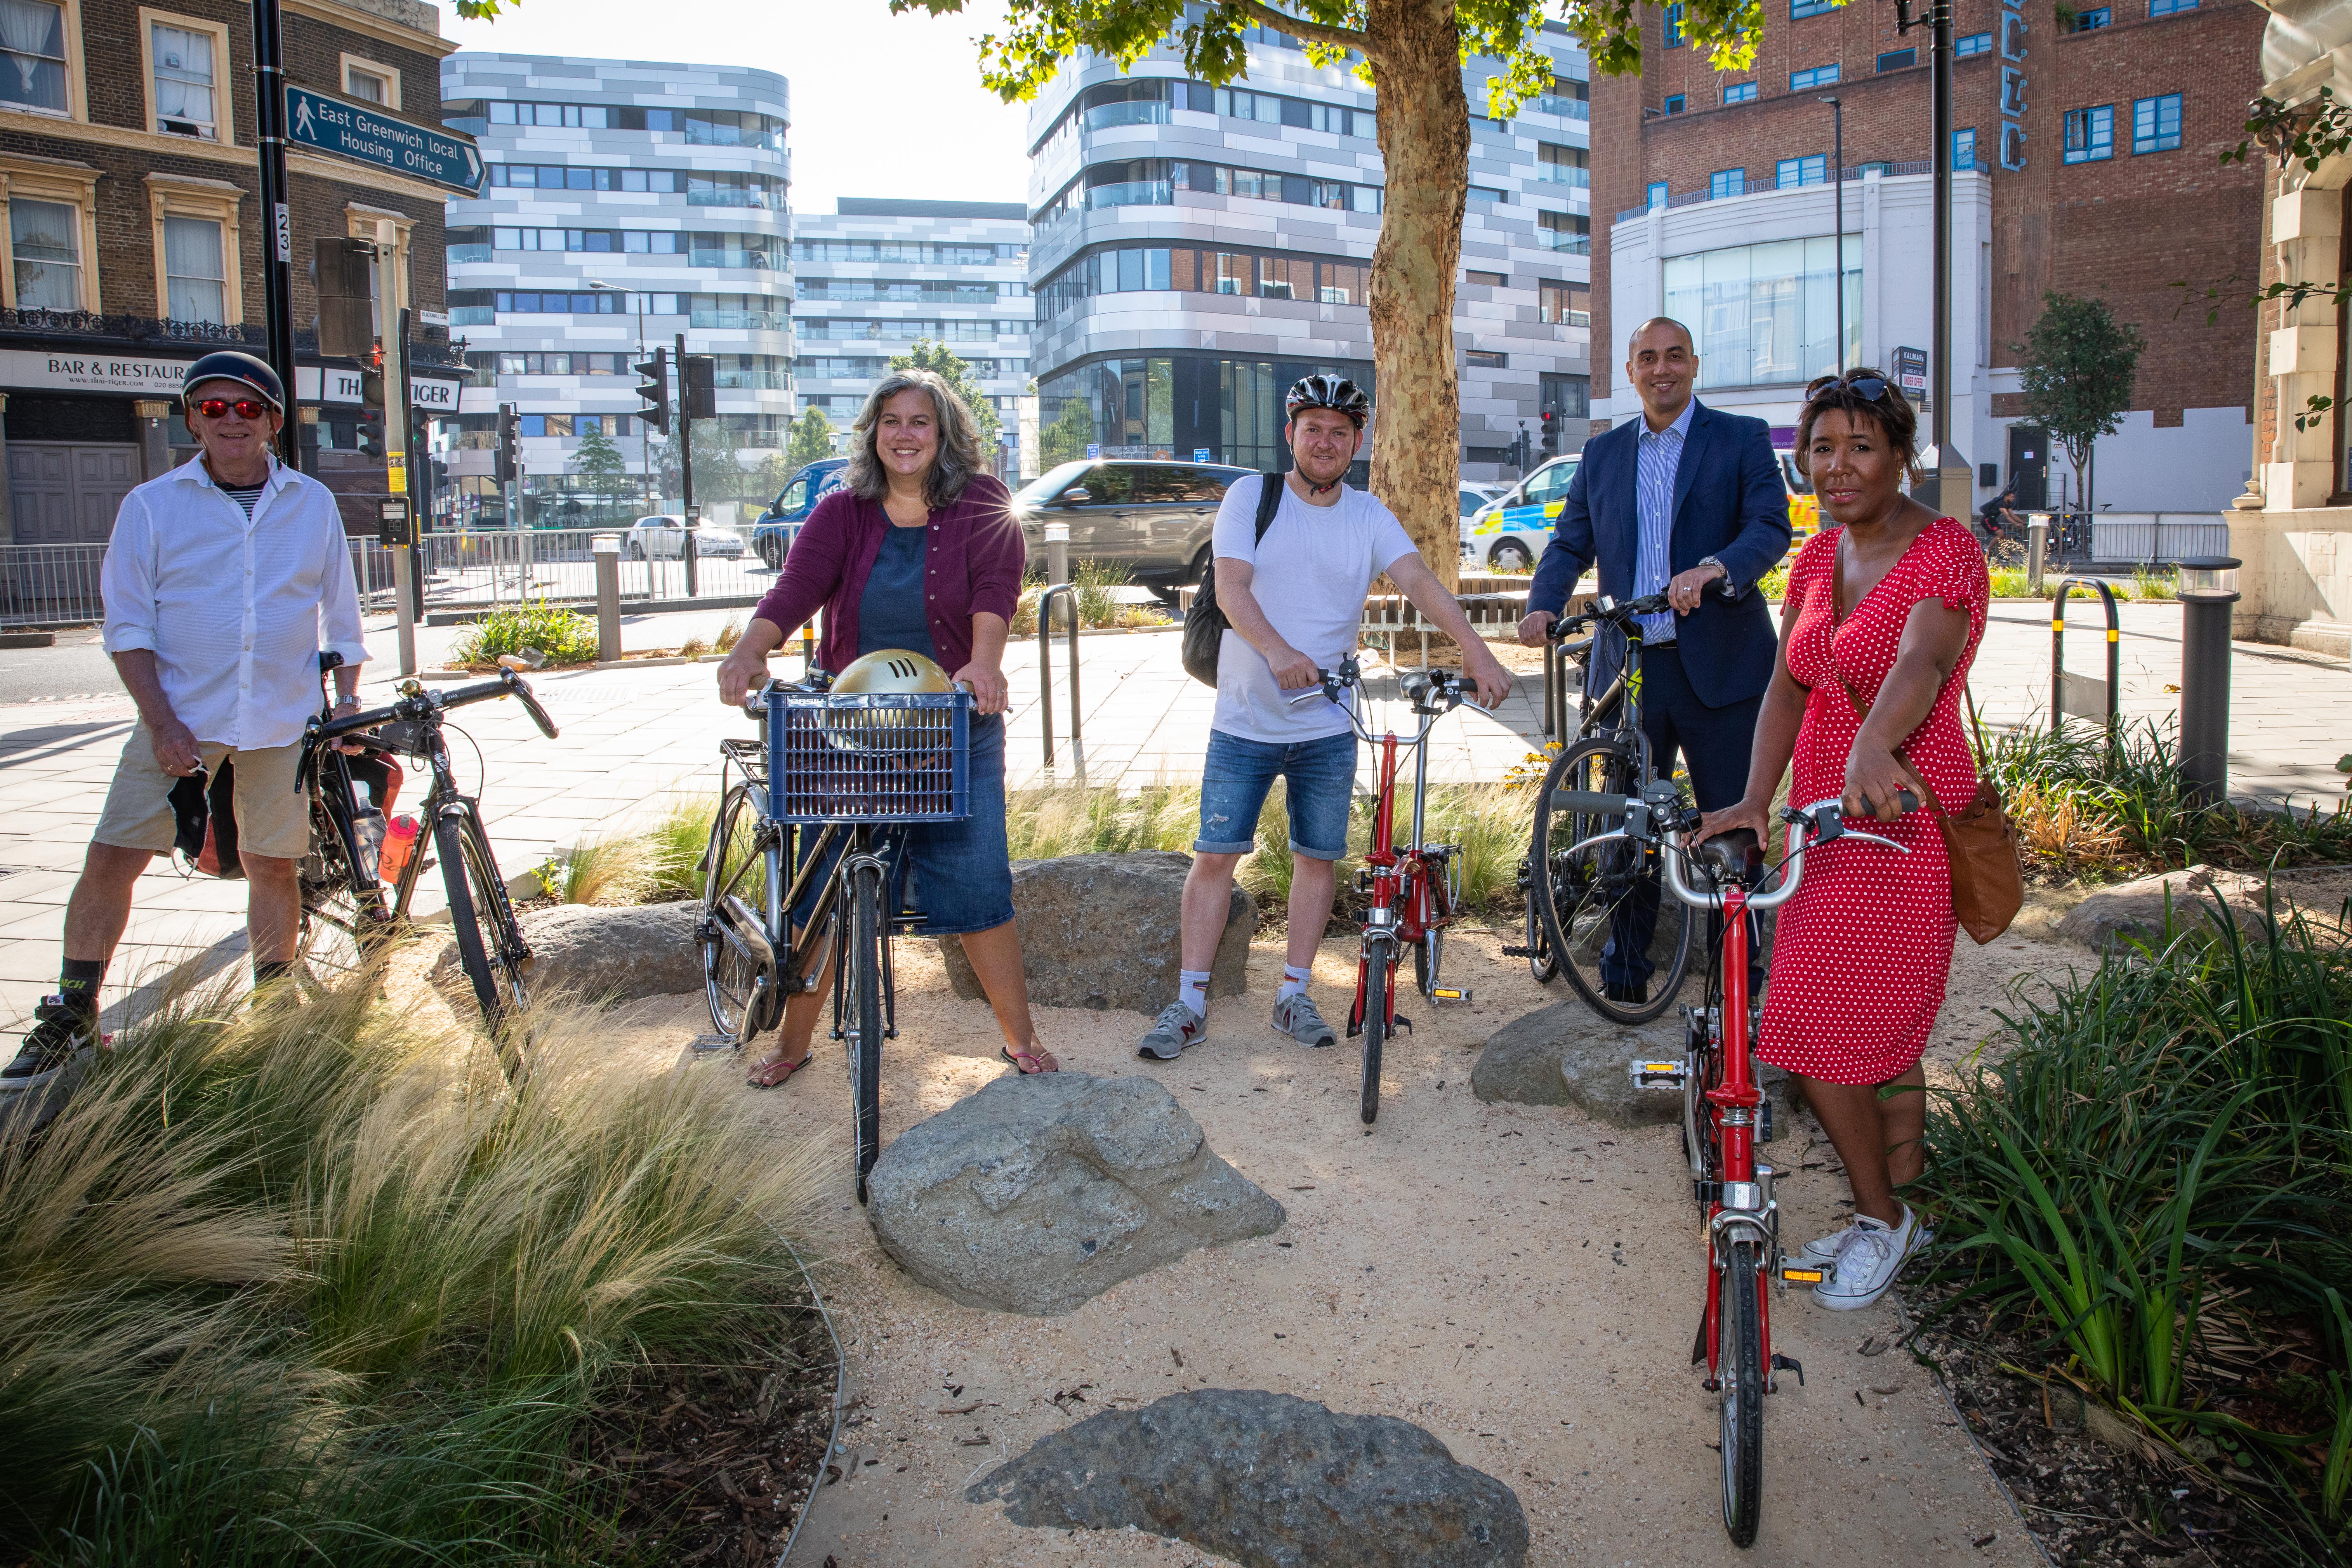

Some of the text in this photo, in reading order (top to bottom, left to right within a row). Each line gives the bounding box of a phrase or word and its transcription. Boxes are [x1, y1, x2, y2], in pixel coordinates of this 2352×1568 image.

[319, 103, 458, 160] East Greenwich local
[341, 130, 443, 175] Housing Office
[49, 359, 84, 374] BAR
[91, 362, 103, 375] &
[338, 378, 362, 396] TH
[1904, 375, 1923, 387] UNDER OFFER
[562, 518, 579, 527] the
